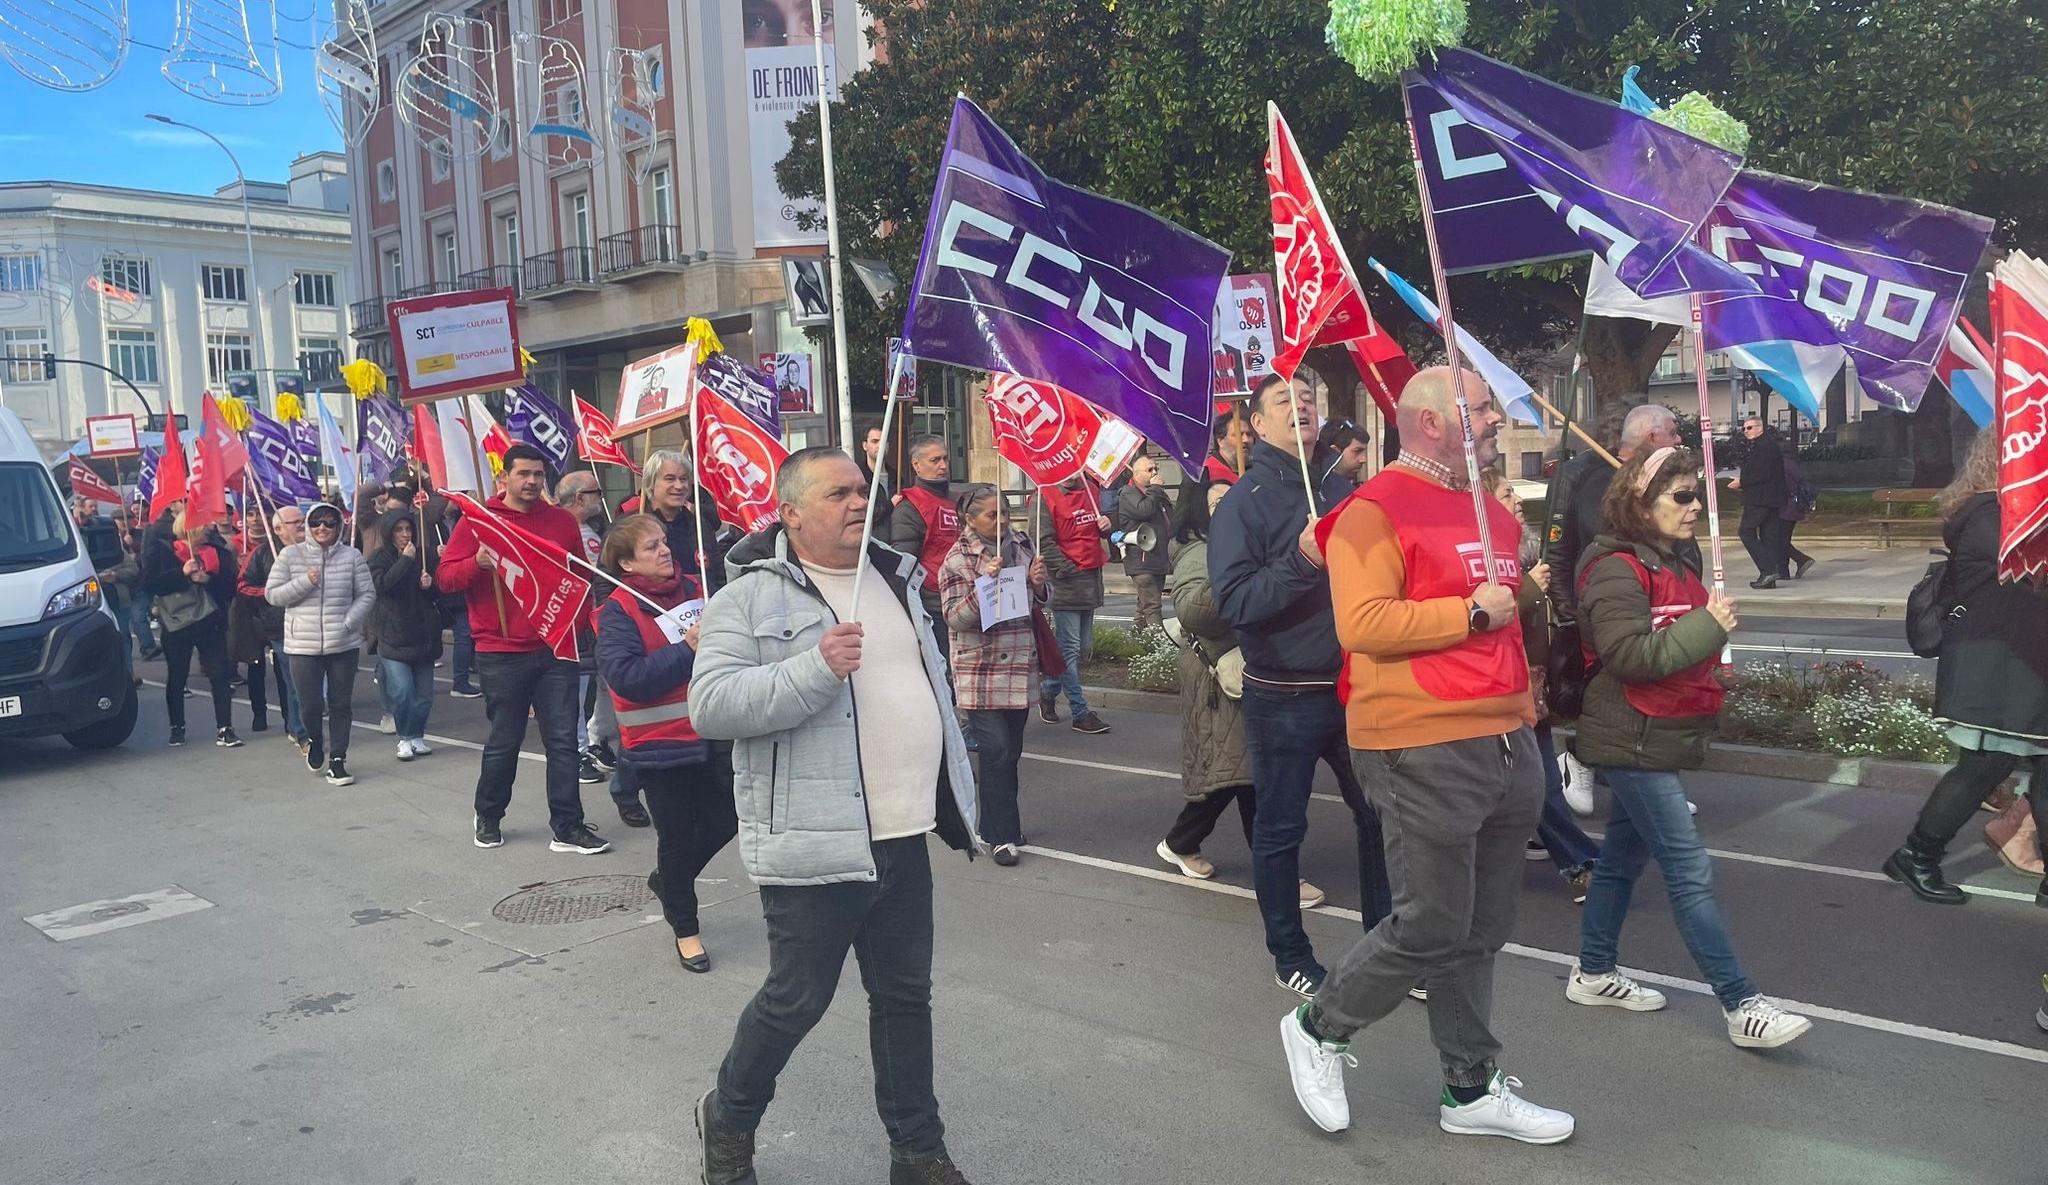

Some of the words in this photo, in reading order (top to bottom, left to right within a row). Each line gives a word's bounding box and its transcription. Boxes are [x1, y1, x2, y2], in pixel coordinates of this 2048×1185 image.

[753, 69, 771, 99] DE
[762, 100, 794, 111] violencia
[937, 200, 1188, 391] CCOO
[416, 327, 436, 340] SCT
[466, 317, 504, 329] CULPABLE
[1468, 558, 1518, 579] COO
